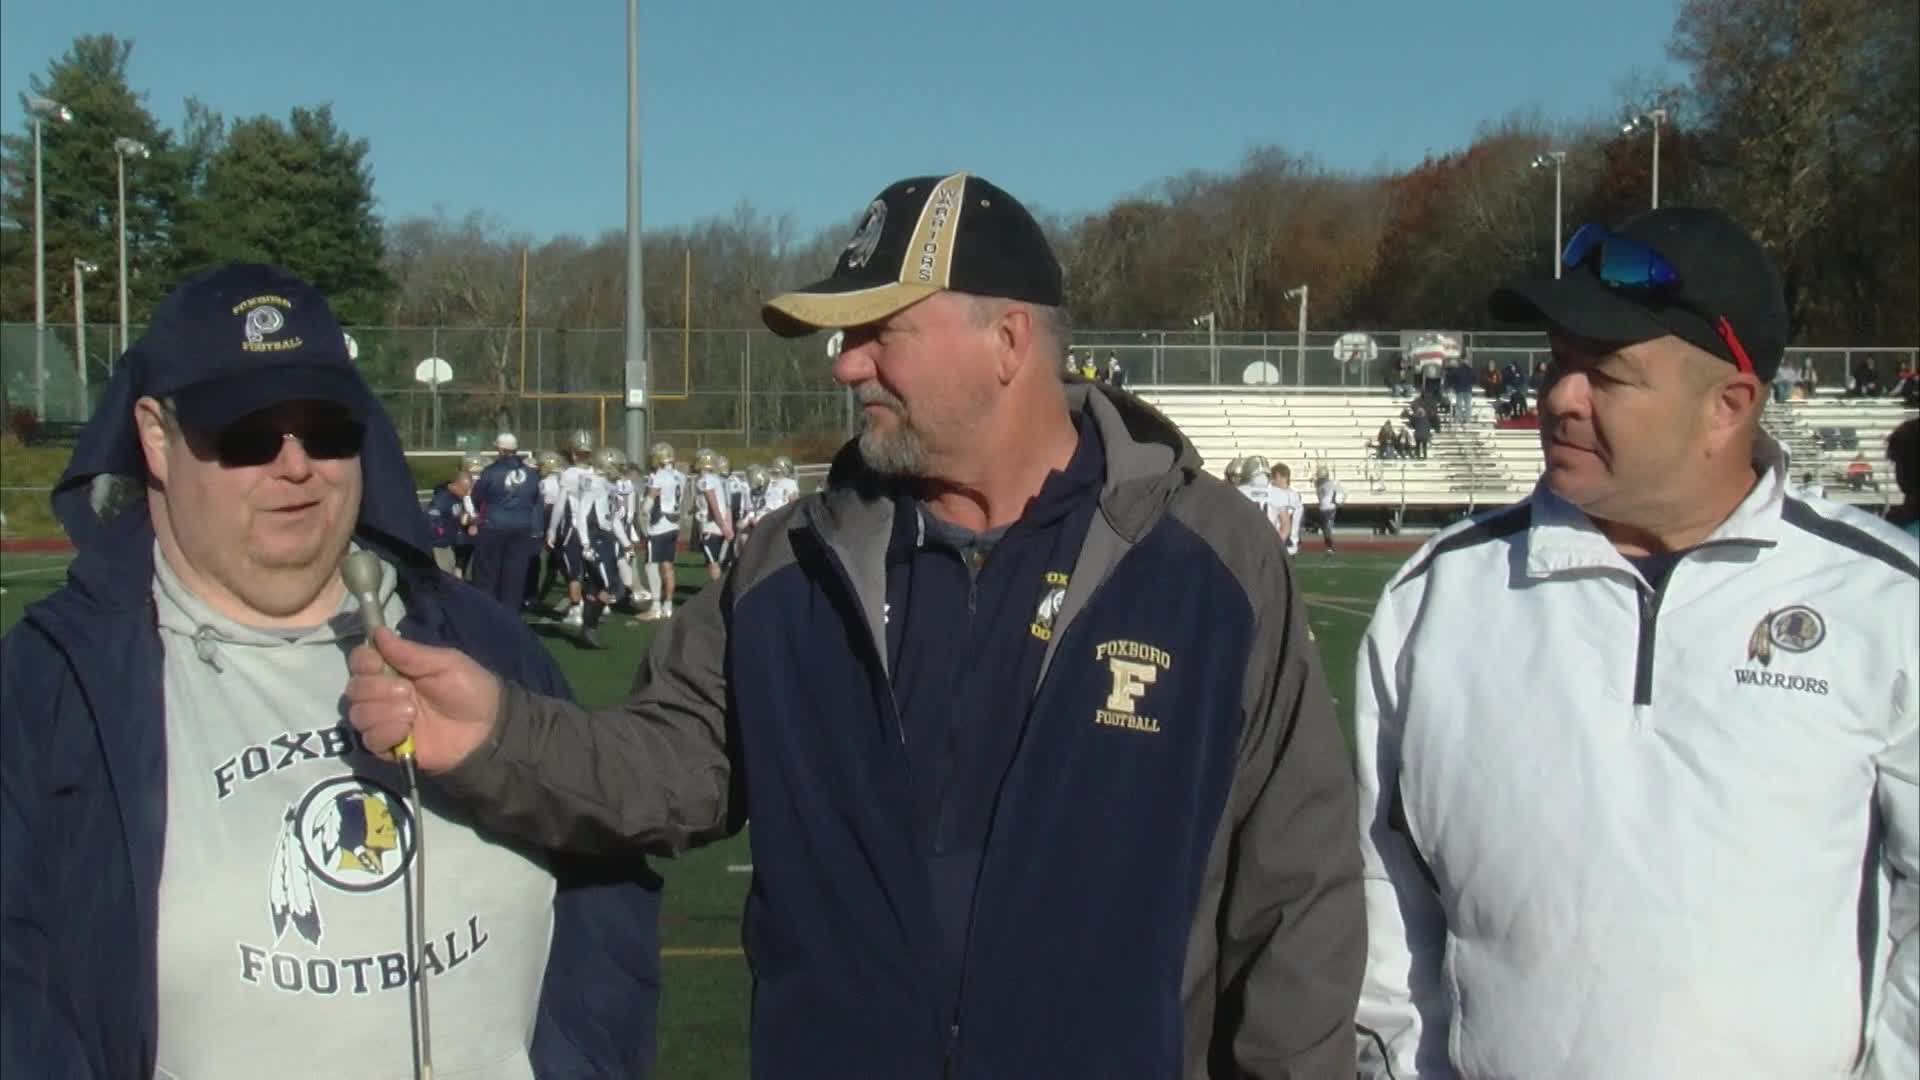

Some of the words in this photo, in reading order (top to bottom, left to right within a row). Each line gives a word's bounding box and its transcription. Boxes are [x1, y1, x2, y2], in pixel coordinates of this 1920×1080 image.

[242, 336, 302, 352] FOOTBALL
[1095, 639, 1171, 670] FOXBORO
[1106, 657, 1157, 713] F
[1735, 668, 1829, 695] WARRIORS
[1095, 709, 1161, 732] FOOTBALL
[213, 726, 353, 800] FOXB
[238, 915, 489, 995] FOOTBALL
